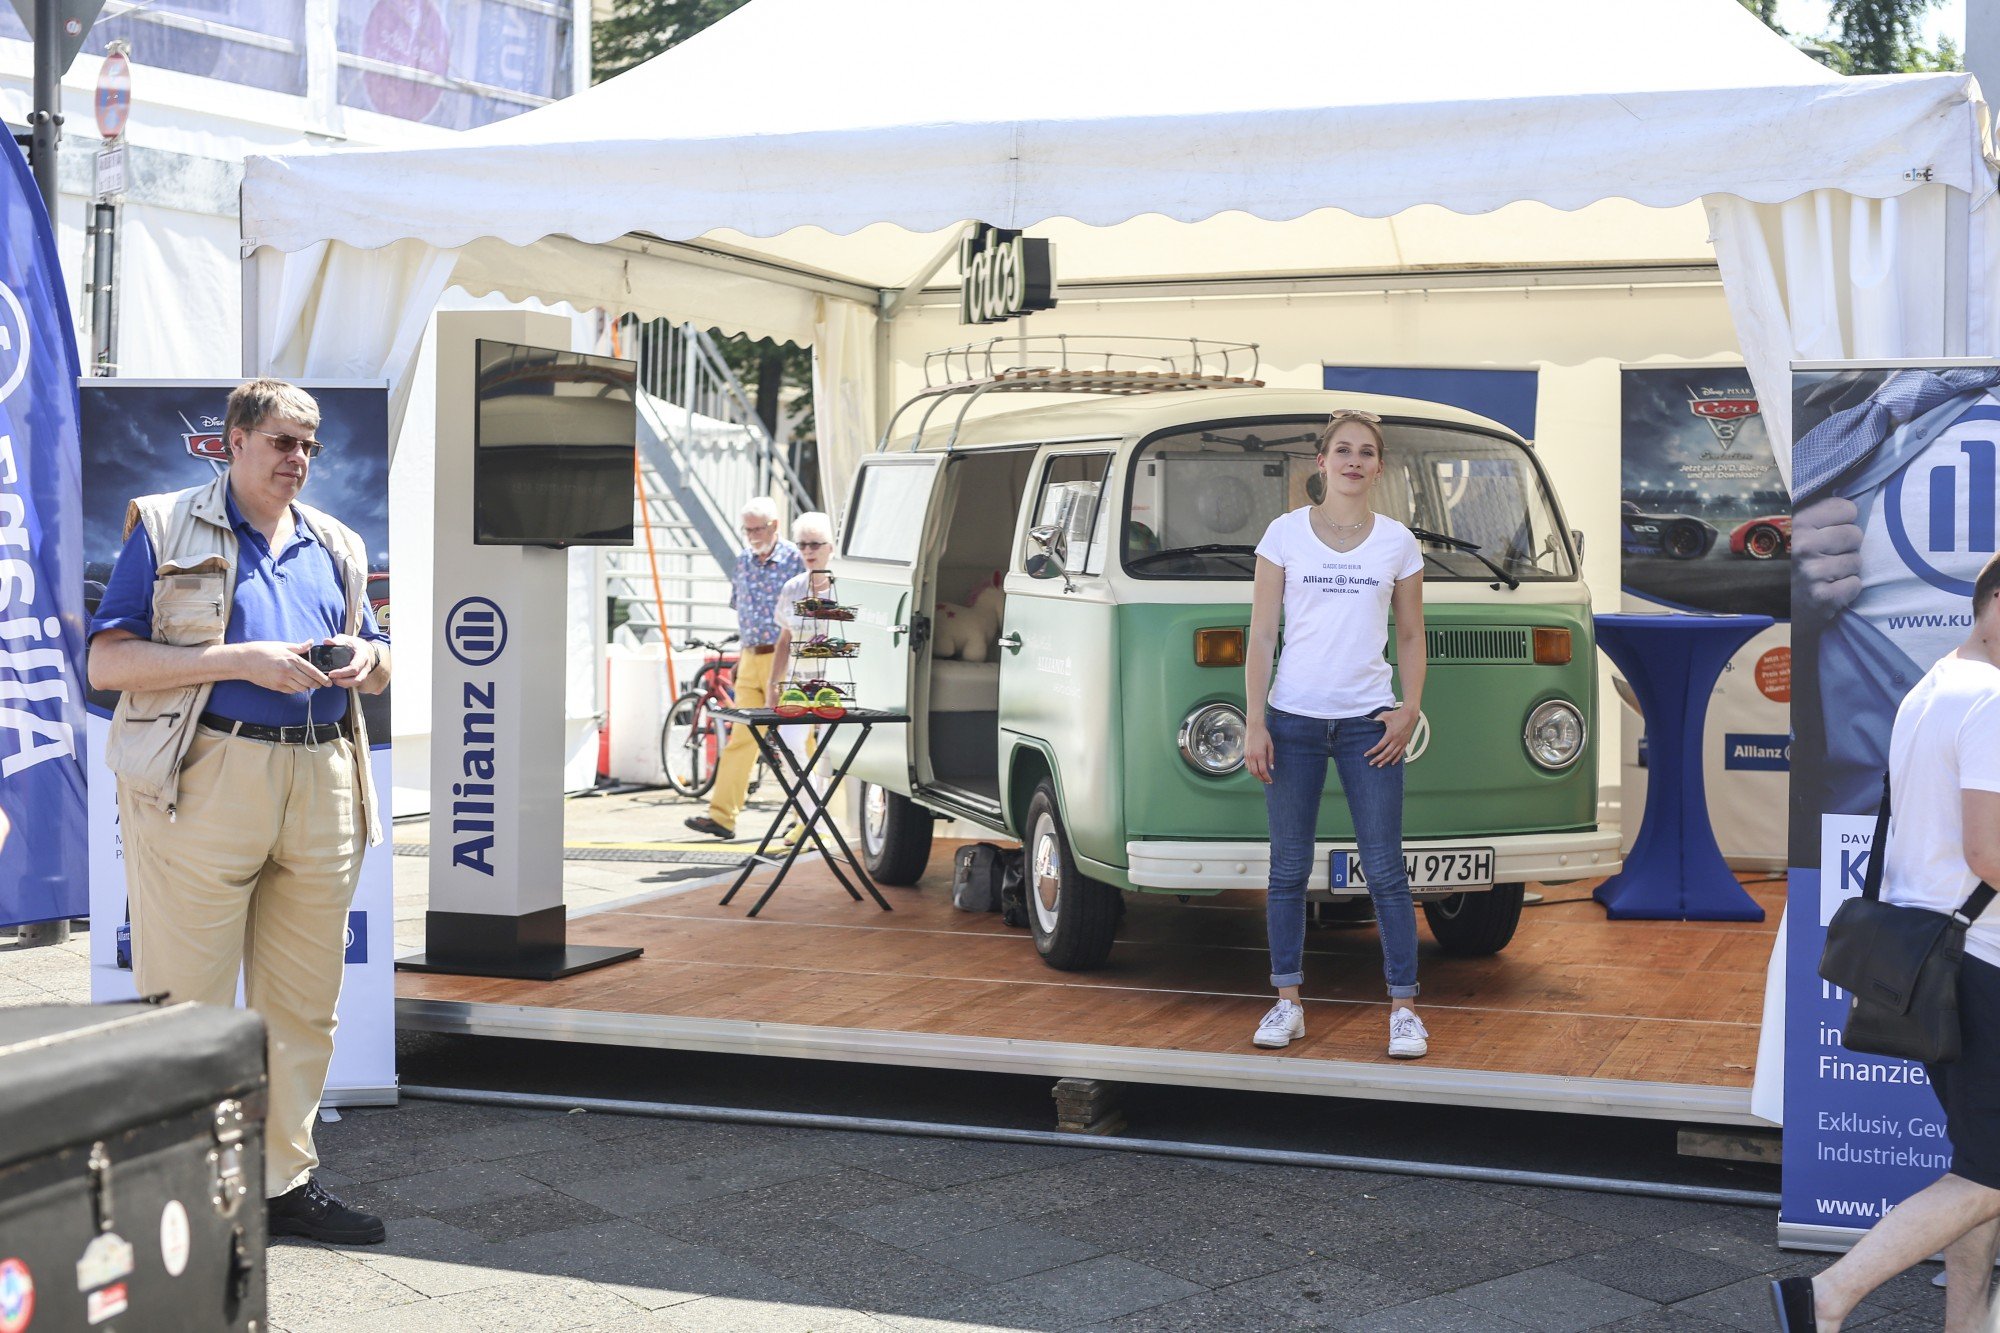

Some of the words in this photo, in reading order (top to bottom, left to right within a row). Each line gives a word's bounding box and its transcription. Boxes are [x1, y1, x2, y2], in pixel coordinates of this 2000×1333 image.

[1698, 402, 1752, 414] Cars
[1718, 424, 1734, 439] 3
[1303, 576, 1333, 584] Allianz
[1349, 577, 1380, 586] Kundler
[1734, 745, 1782, 758] Allianz
[452, 681, 495, 877] Allianz
[1841, 833, 1874, 844] DAV
[1425, 853, 1490, 882] 973H
[1818, 1111, 1902, 1139] Exklusiv,
